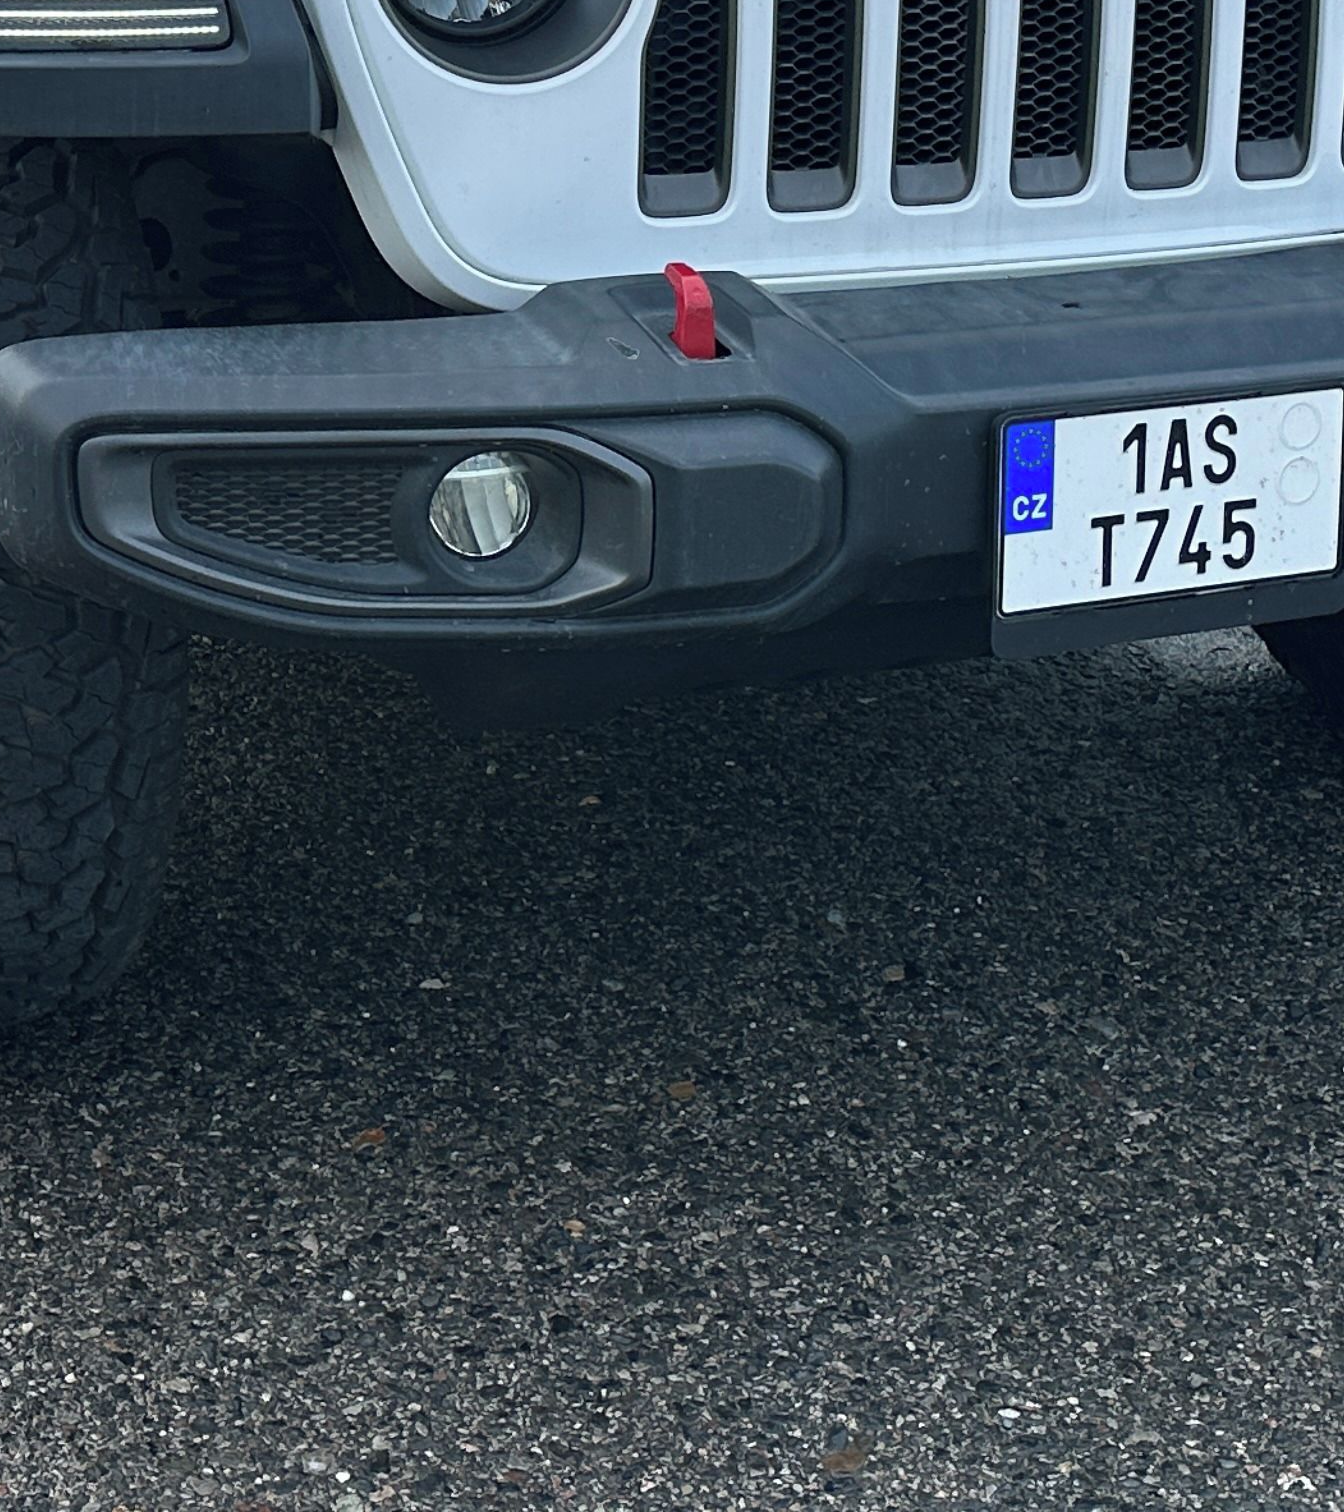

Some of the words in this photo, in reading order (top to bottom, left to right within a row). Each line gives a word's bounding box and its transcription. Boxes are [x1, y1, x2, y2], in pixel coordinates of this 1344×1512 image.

[1012, 493, 1048, 521] CZ
[1123, 414, 1238, 494] 1AS
[1090, 498, 1257, 587] T745
